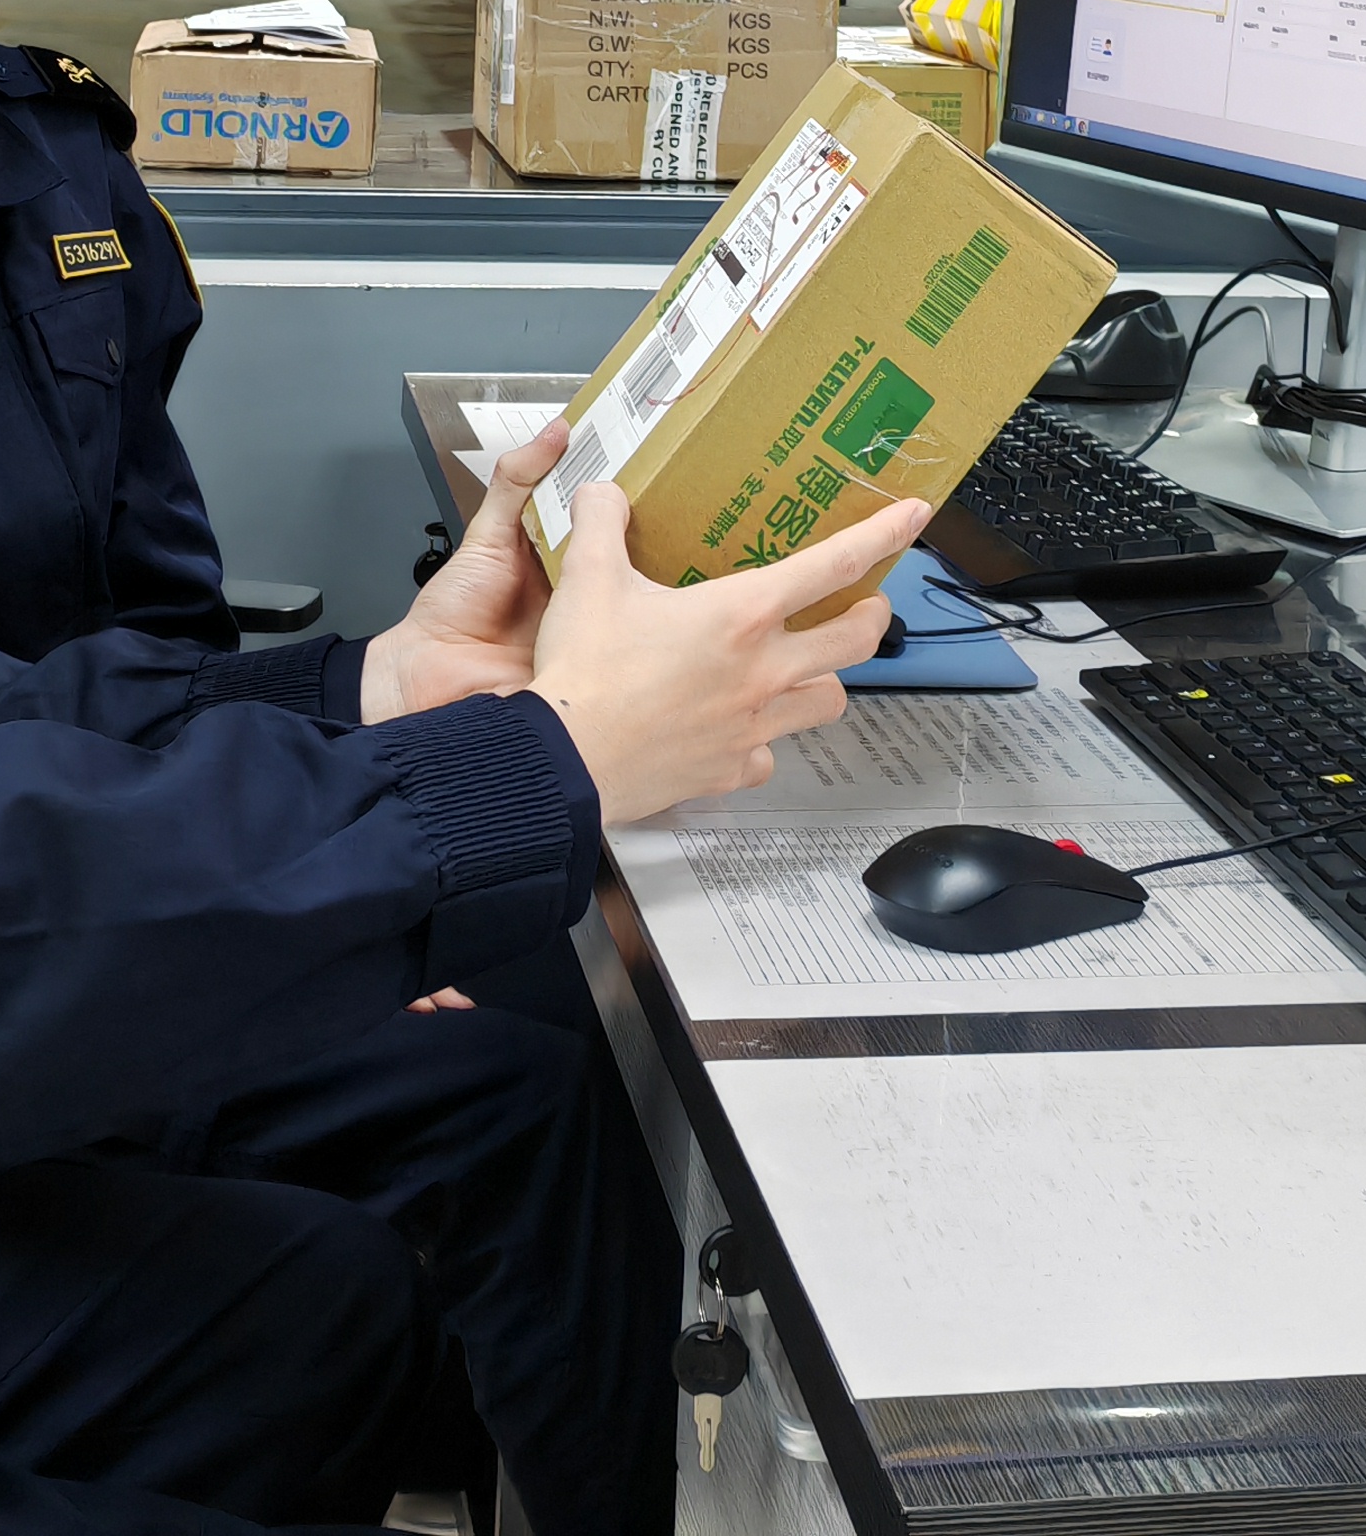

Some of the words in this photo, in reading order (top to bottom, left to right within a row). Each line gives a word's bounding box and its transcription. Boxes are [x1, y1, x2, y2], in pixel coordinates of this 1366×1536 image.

[728, 12, 772, 30] KGS
[588, 35, 635, 52] G.W:
[727, 38, 771, 54] KGS
[587, 60, 635, 80] QTY:
[727, 63, 769, 79] PCS
[160, 109, 351, 149] ARNOLD
[63, 240, 120, 265] 5316291
